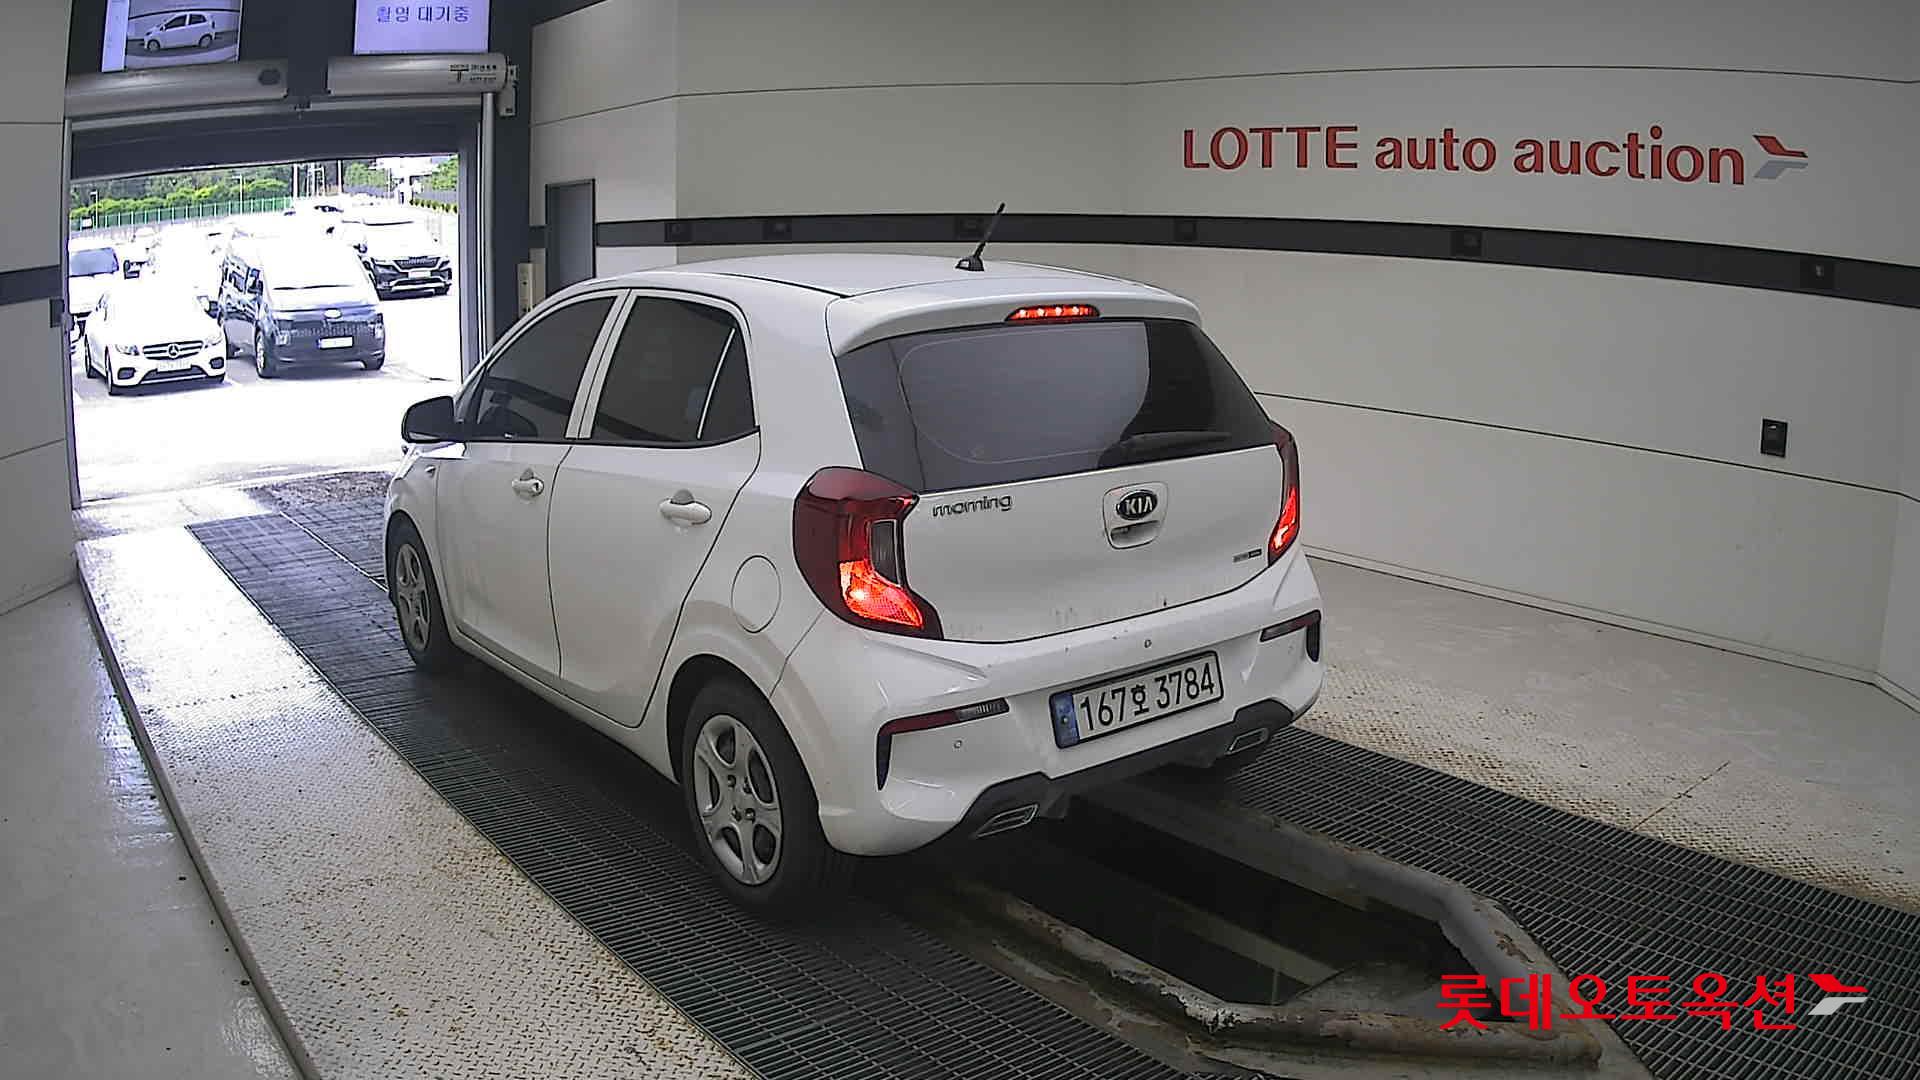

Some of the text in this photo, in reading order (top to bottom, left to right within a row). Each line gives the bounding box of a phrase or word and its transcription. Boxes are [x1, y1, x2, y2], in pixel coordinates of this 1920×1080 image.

[417, 5, 468, 23] 대기중
[1183, 125, 1745, 185] LOTTE auto auction
[932, 495, 1012, 517] morning
[1125, 496, 1153, 515] KIA
[1080, 662, 1215, 731] 167호 3784
